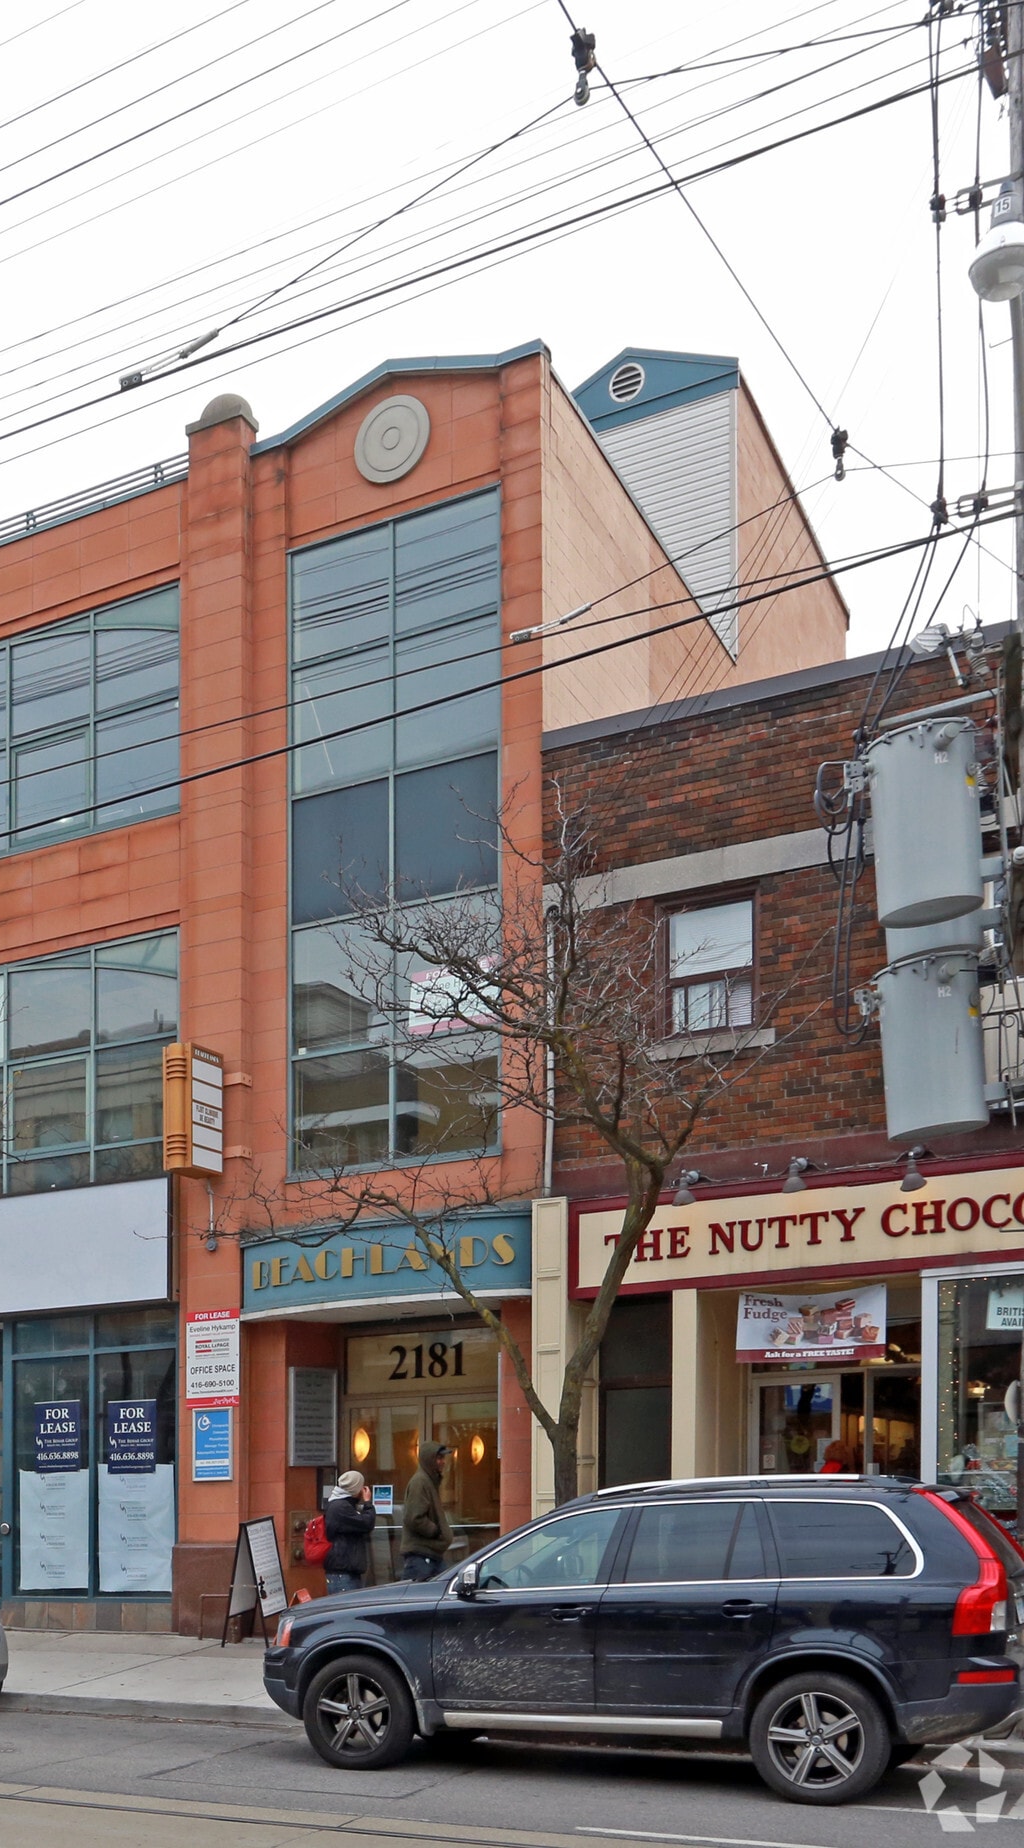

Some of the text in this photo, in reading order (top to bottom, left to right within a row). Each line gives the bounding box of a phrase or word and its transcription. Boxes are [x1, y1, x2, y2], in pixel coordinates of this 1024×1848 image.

[996, 198, 1010, 213] 15
[934, 751, 949, 764] H2
[937, 985, 952, 998] H2
[708, 1206, 866, 1256] NUTTY
[744, 1294, 783, 1308] Fresh
[195, 1310, 230, 1321] FOR LEASE
[743, 1307, 788, 1323] Fudge
[825, 1348, 855, 1357] TASTE!
[388, 1340, 467, 1380] 2181
[190, 1363, 236, 1375] OFFICE SPACE
[190, 1379, 235, 1388] 416-690-5100
[45, 1408, 70, 1420] FOR
[119, 1407, 145, 1419] FOR
[39, 1421, 76, 1434] LEASE
[113, 1421, 152, 1434] LEASE
[109, 1452, 155, 1461] 416.636.8898
